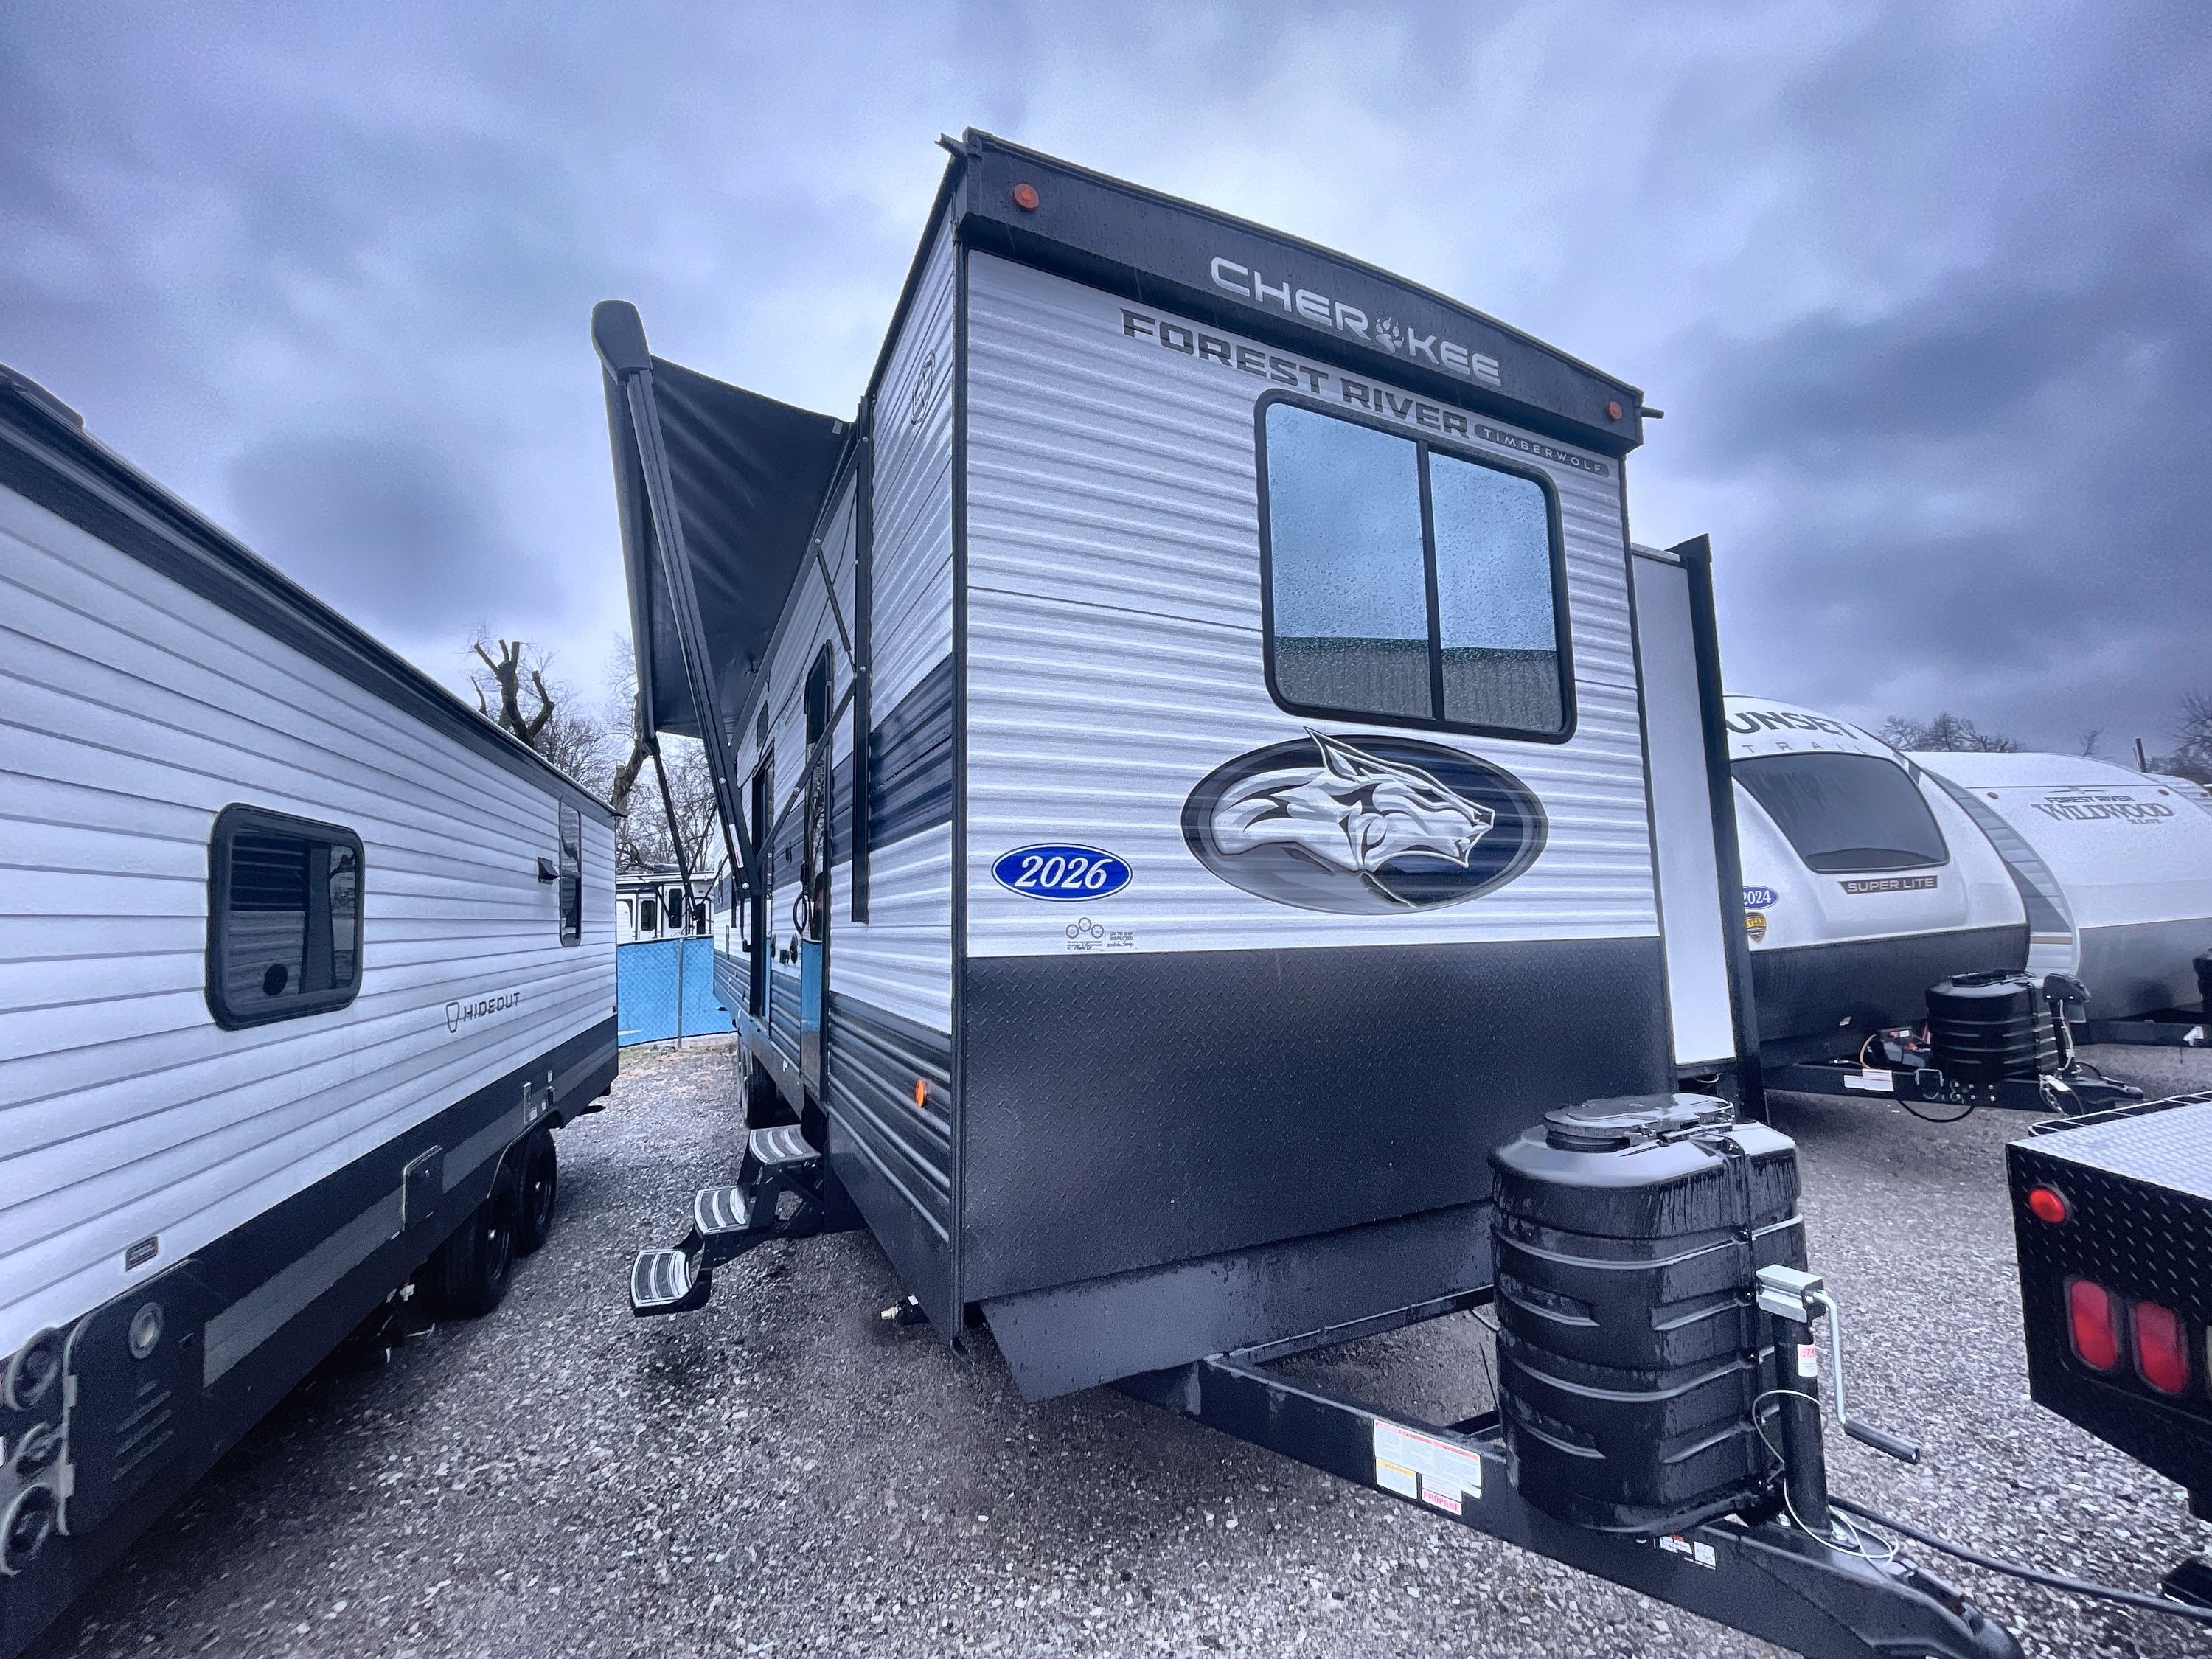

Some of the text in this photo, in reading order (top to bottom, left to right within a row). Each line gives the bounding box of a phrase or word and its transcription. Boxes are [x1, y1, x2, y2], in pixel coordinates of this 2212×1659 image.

[1120, 307, 1470, 439] FOREST RIVER
[1484, 428, 1601, 473] TIMBERWOLF
[1726, 711, 1859, 740] UNSET
[1741, 741, 1867, 754] TRAIL
[2030, 803, 2174, 821] WILDWOOD
[1015, 855, 1113, 890] 2026
[1847, 877, 1933, 892] SUPER LITE
[1743, 889, 1772, 905] 2024
[463, 992, 521, 1022] HIDEOUT
[1422, 1489, 1460, 1512] PROPANE
